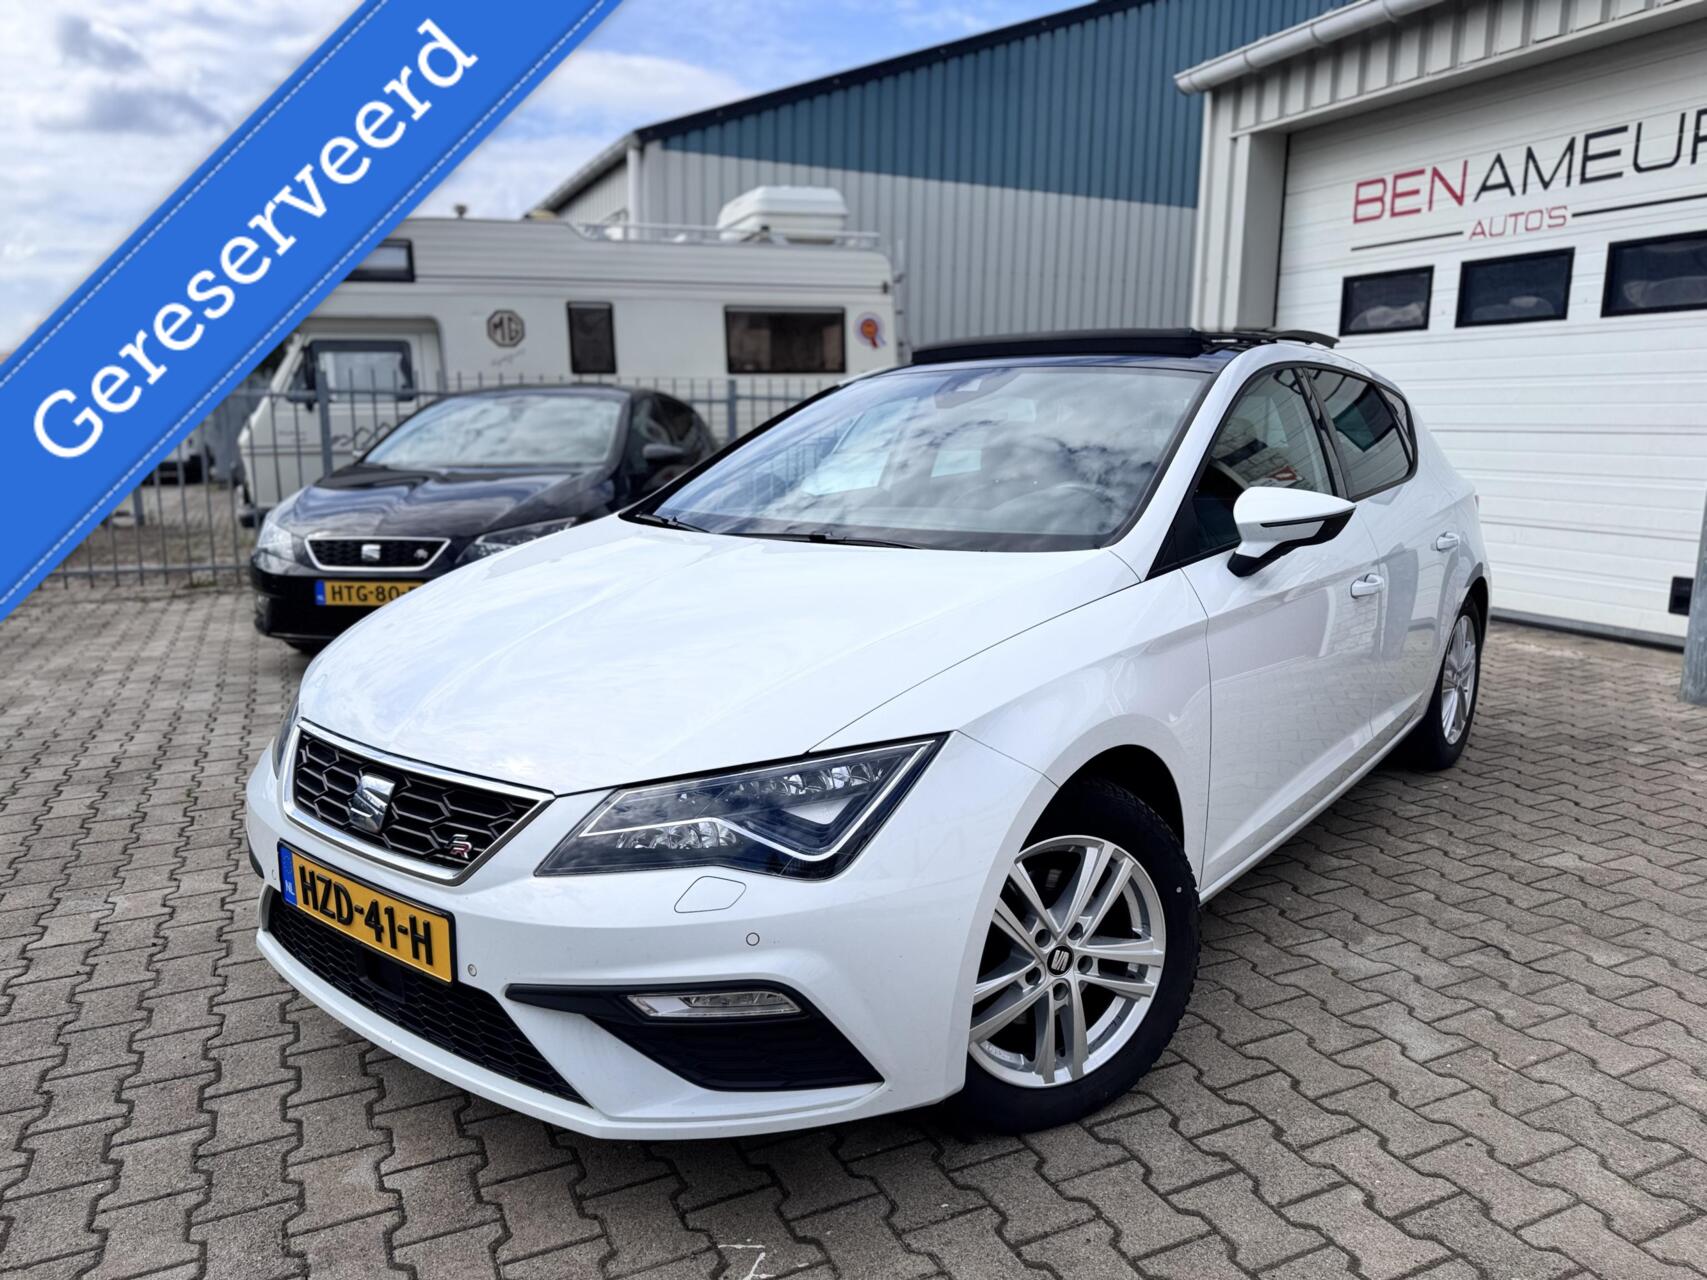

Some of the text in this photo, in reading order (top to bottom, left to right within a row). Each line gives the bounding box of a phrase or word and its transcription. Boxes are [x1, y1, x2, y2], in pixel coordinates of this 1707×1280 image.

[1469, 205, 1568, 241] AUTO'S
[491, 314, 522, 343] MG
[298, 863, 434, 967] HZD-41-H
